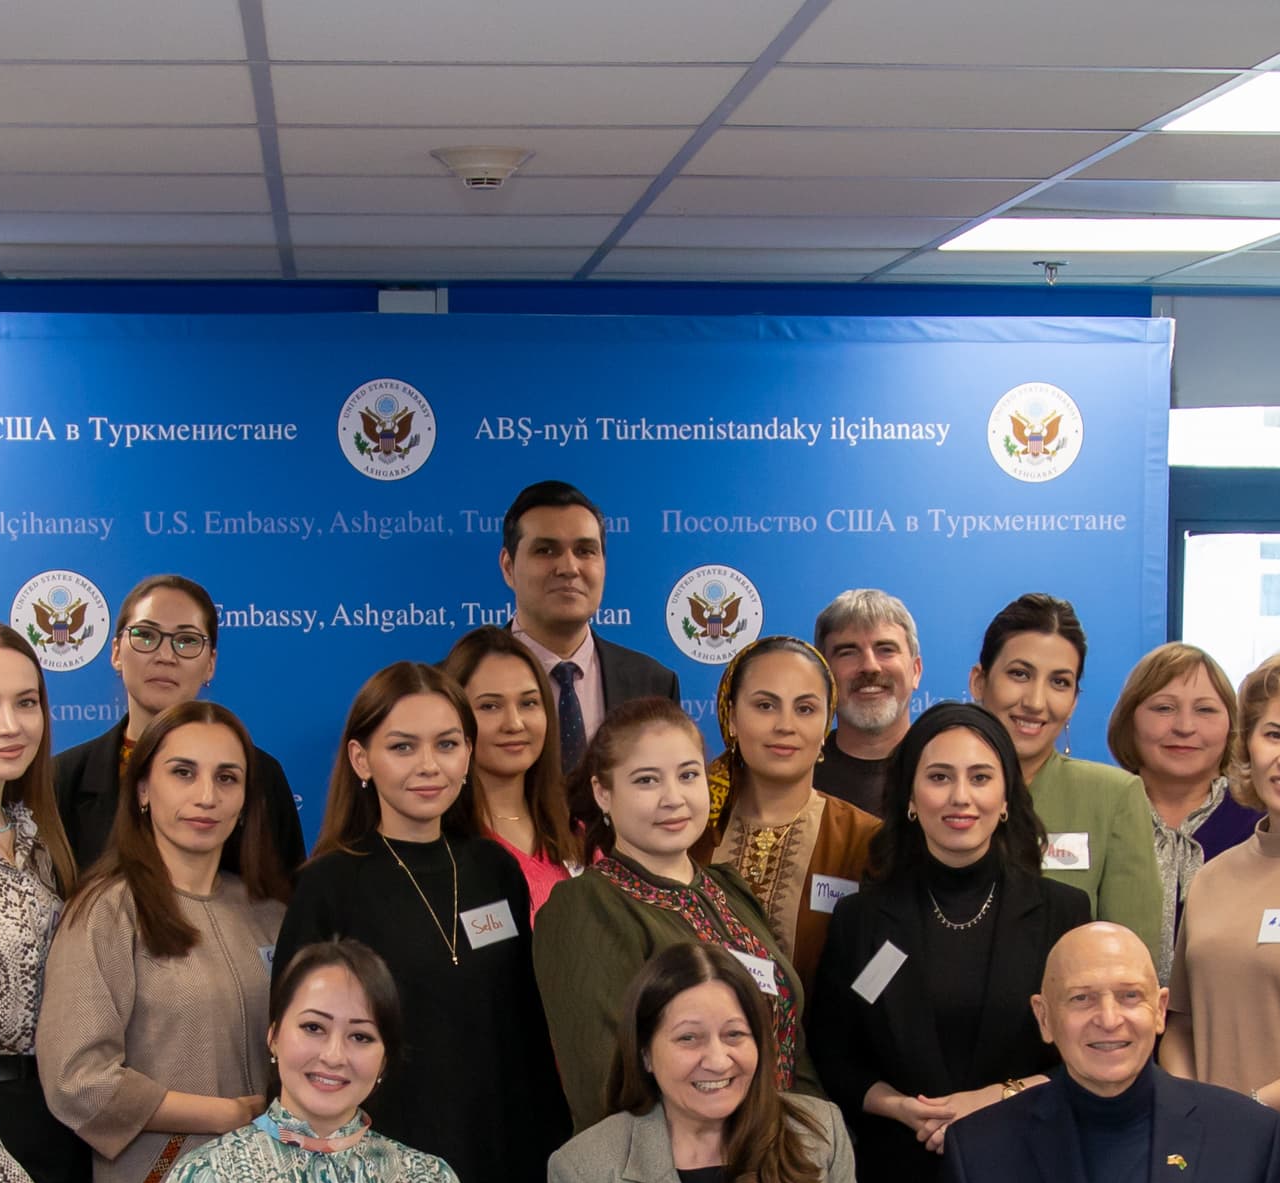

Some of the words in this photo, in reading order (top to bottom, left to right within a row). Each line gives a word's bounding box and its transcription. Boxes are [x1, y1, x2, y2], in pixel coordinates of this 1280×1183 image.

[343, 390, 367, 418] UNITED
[367, 382, 400, 393] STATES
[401, 386, 431, 418] EMBASSY
[66, 423, 80, 440] в
[88, 417, 298, 447] Туркменистане
[474, 417, 589, 446] ABŞ-nyň
[596, 417, 822, 446] Türkmenistandaky
[830, 417, 951, 446] ilçihanasy
[364, 464, 411, 478] ASHGABAT
[143, 511, 195, 535] U.S.
[204, 511, 323, 540] Embassy,
[329, 510, 454, 540] Ashgabat,
[661, 510, 817, 533] Посольство
[825, 509, 895, 533] США
[906, 515, 919, 532] в
[927, 508, 1127, 538] Туркменистане
[16, 581, 39, 610] UNITED
[41, 574, 73, 584] STATES
[75, 577, 105, 609] EMBASSY
[672, 575, 695, 604] UNITED
[696, 568, 728, 579] STATES
[730, 572, 758, 603] EMBASSY
[331, 602, 457, 633] Ashgabat,
